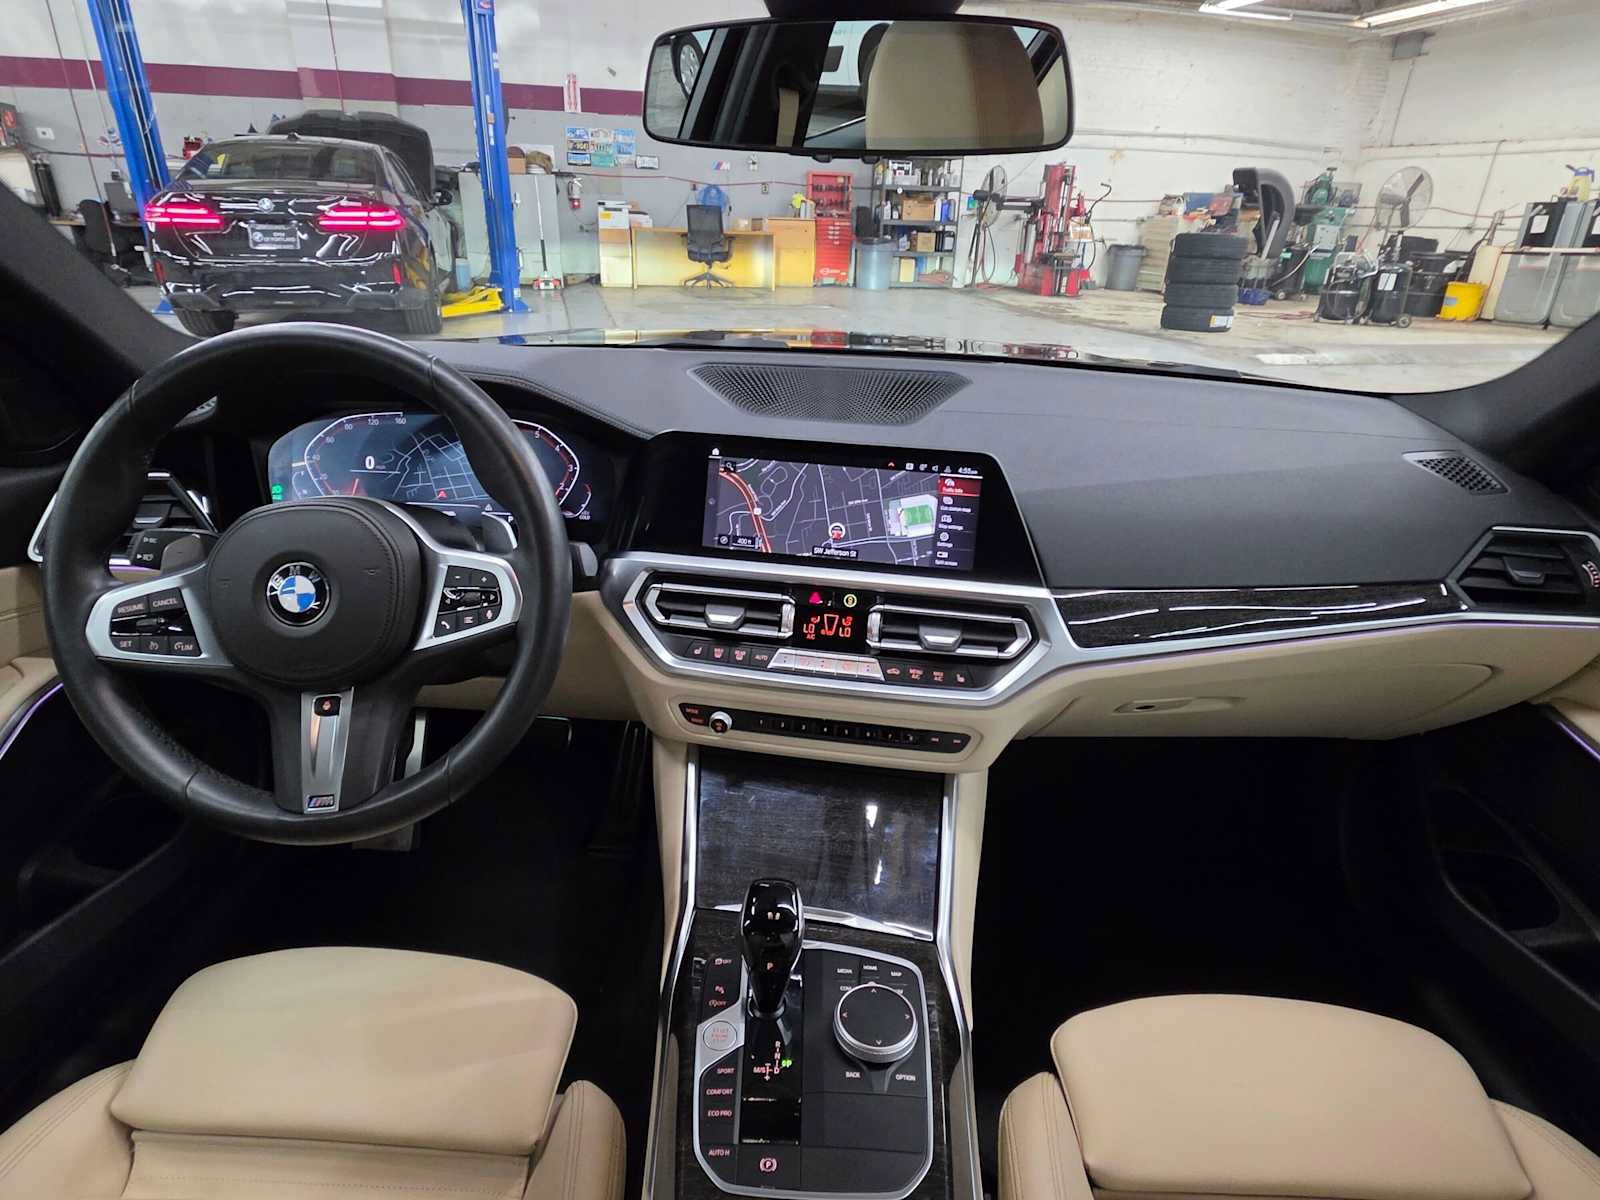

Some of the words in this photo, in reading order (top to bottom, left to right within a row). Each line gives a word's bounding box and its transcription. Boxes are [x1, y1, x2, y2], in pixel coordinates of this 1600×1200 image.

[368, 418, 379, 426] 120
[365, 456, 375, 469] 0
[568, 464, 573, 472] 3
[737, 537, 748, 545] 400
[824, 548, 848, 556] Jefferson
[271, 565, 321, 588] BMW
[118, 603, 144, 613] RESUME
[152, 598, 178, 607] CANCEL
[803, 624, 815, 634] LO
[839, 628, 851, 638] LO
[120, 640, 133, 648] SET
[767, 962, 773, 970] P
[706, 1088, 733, 1096] COMFORT
[708, 1148, 724, 1156] AUTO
